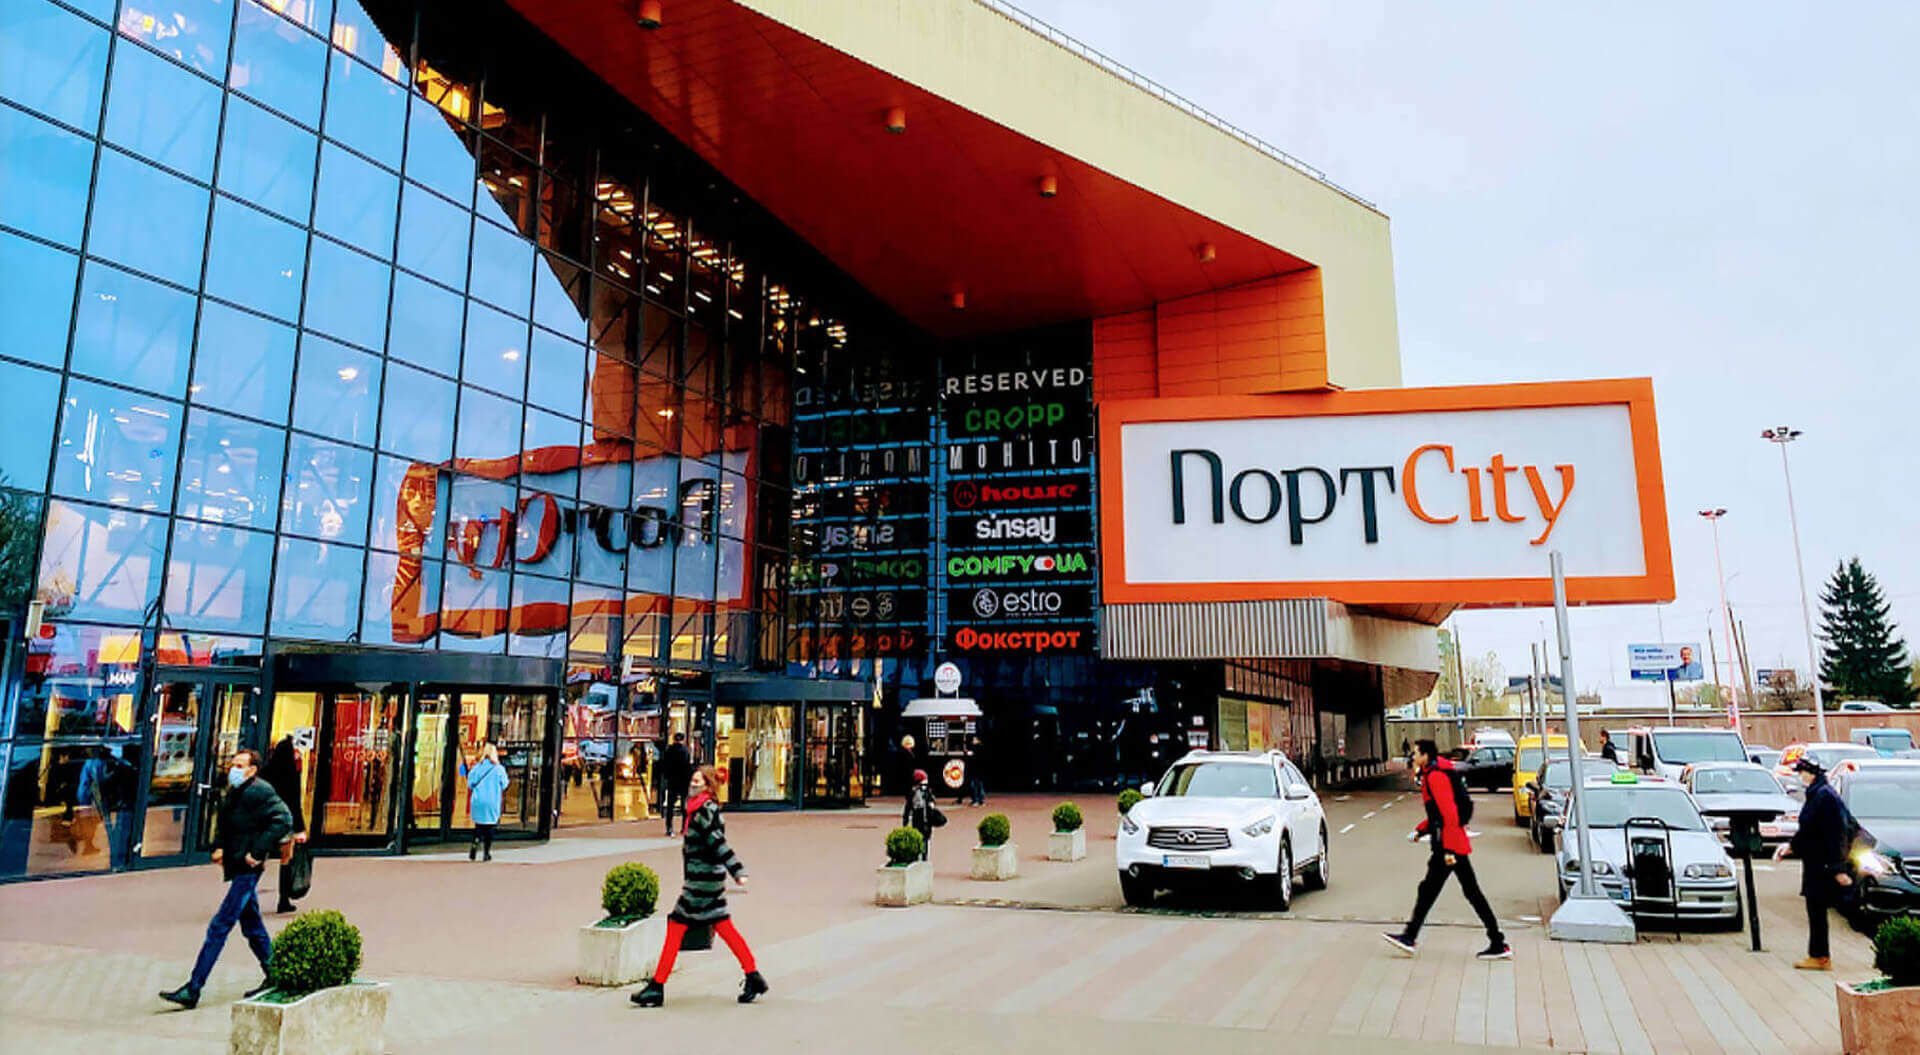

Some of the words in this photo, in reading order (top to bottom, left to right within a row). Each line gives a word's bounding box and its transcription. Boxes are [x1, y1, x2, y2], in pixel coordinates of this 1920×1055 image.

[946, 368, 1085, 394] RESERVED
[965, 403, 1064, 431] CROPP
[950, 437, 1081, 470] MOHITO
[976, 513, 1056, 543] sinsay
[1003, 588, 1062, 612] estro
[955, 627, 1080, 652] Фокстрот
